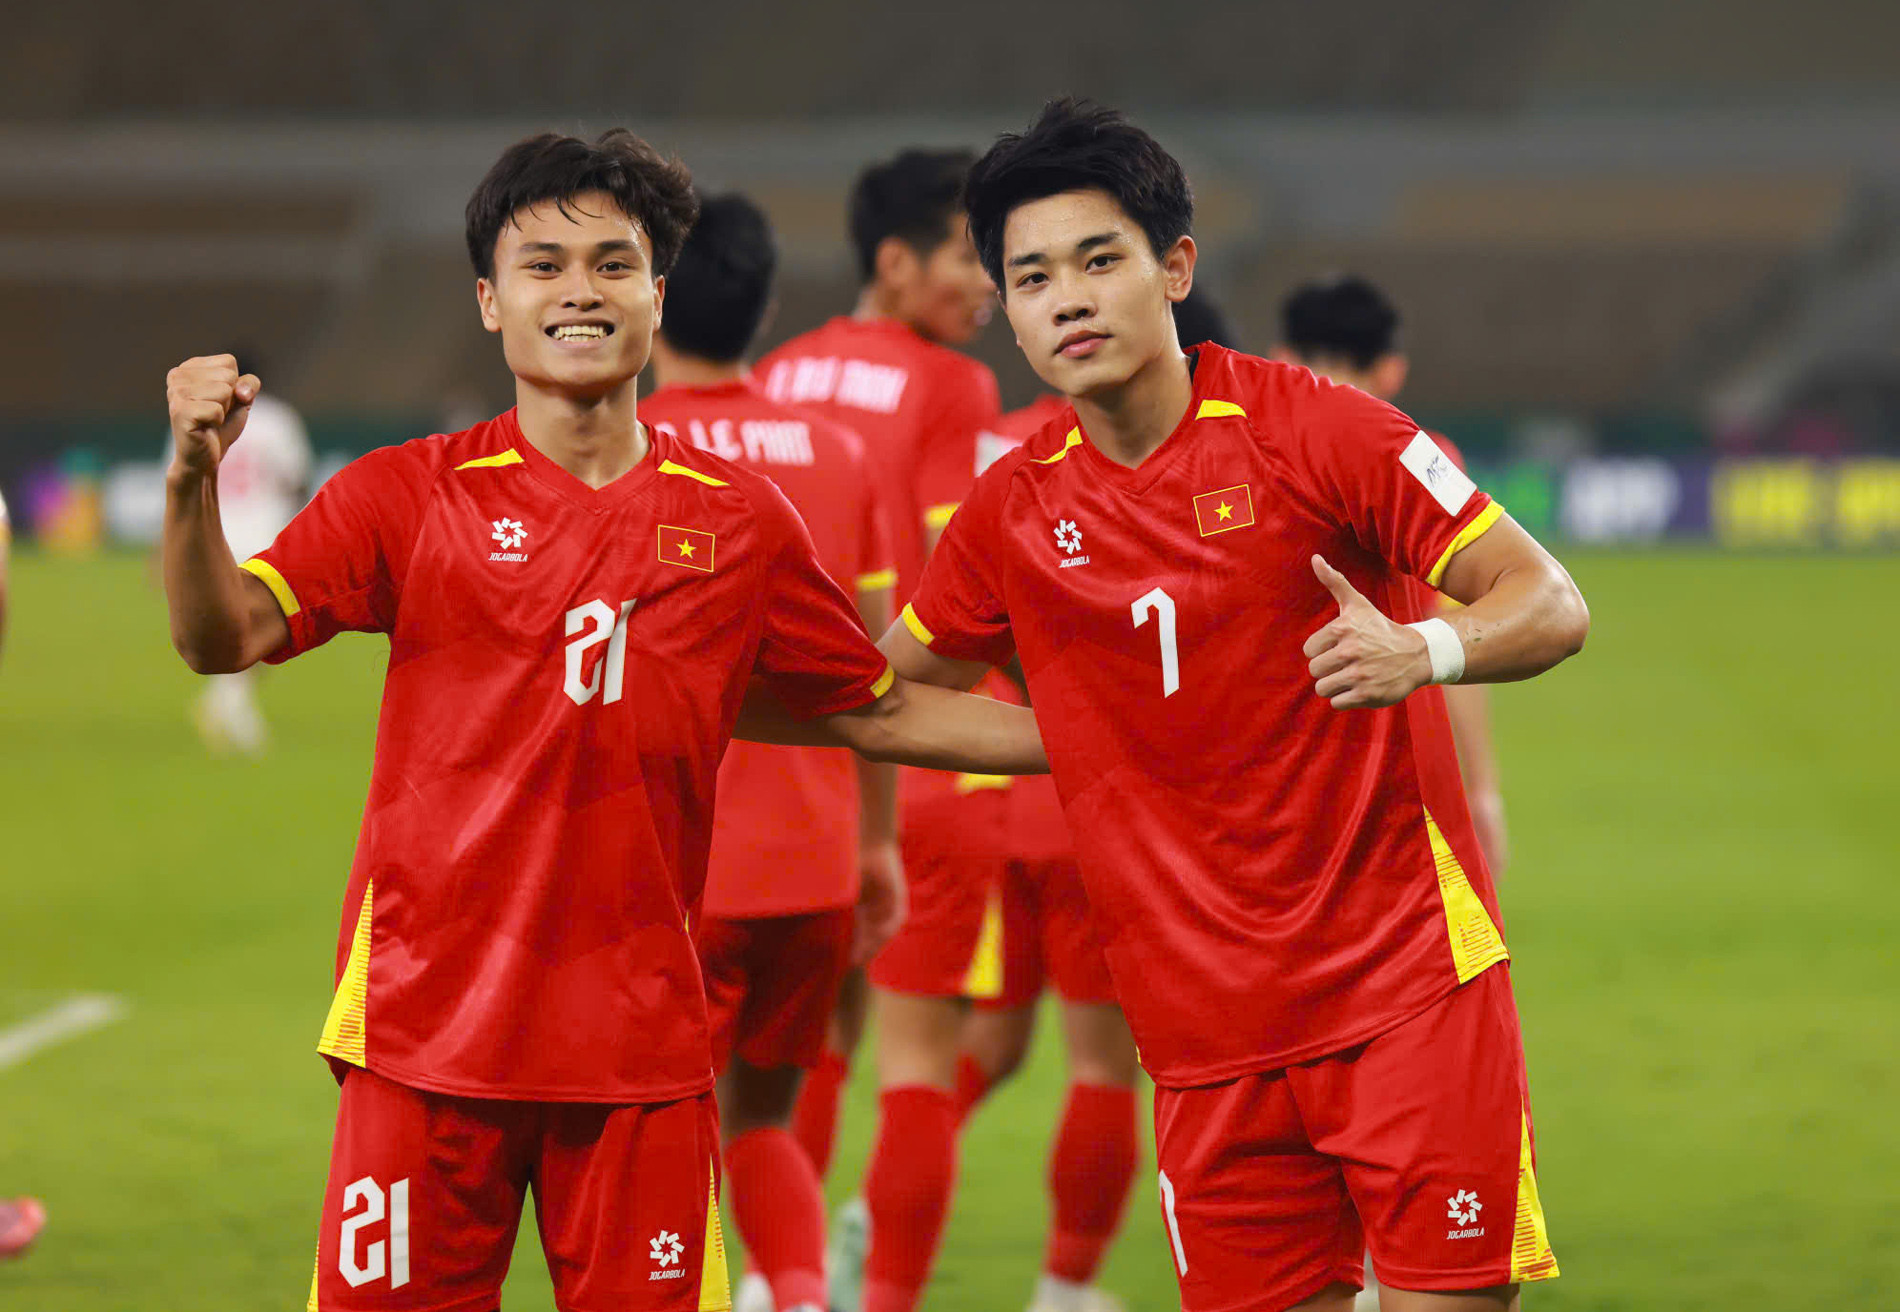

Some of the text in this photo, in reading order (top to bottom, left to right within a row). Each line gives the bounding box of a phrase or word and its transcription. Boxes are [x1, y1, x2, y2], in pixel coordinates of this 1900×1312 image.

[563, 598, 638, 706] 21
[1131, 586, 1180, 699] 7
[338, 1176, 410, 1290] 21
